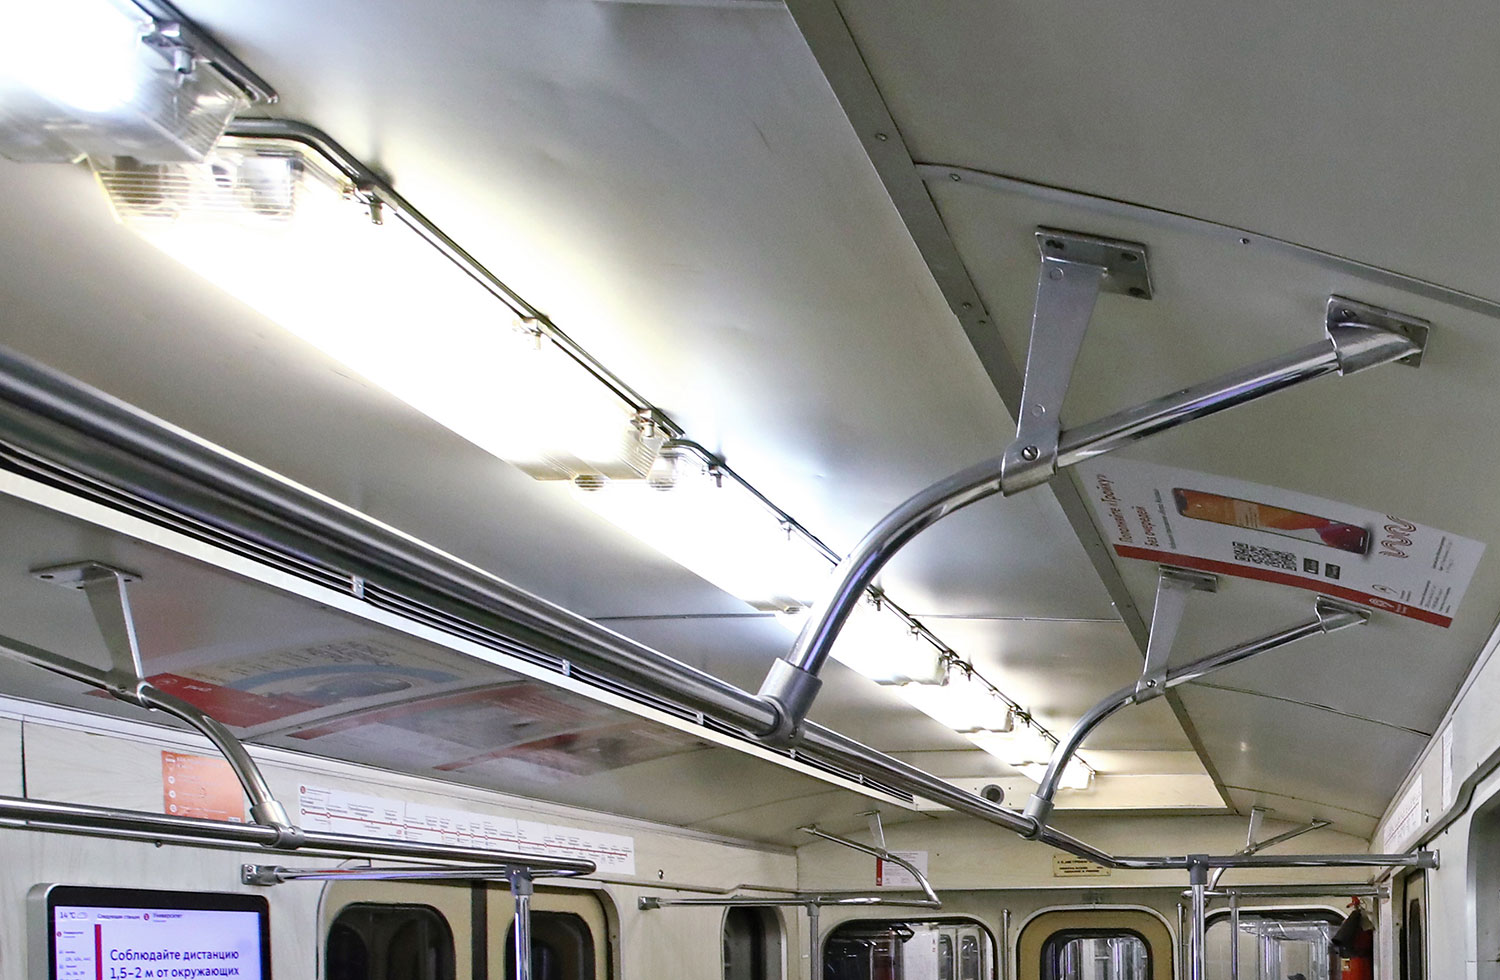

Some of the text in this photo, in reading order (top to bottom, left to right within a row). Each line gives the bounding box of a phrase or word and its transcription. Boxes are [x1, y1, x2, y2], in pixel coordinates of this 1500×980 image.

[110, 949, 239, 962] Соблюдайте дистанцию
[145, 969, 154, 978] м
[157, 968, 169, 977] от
[172, 966, 239, 980] окружающих
